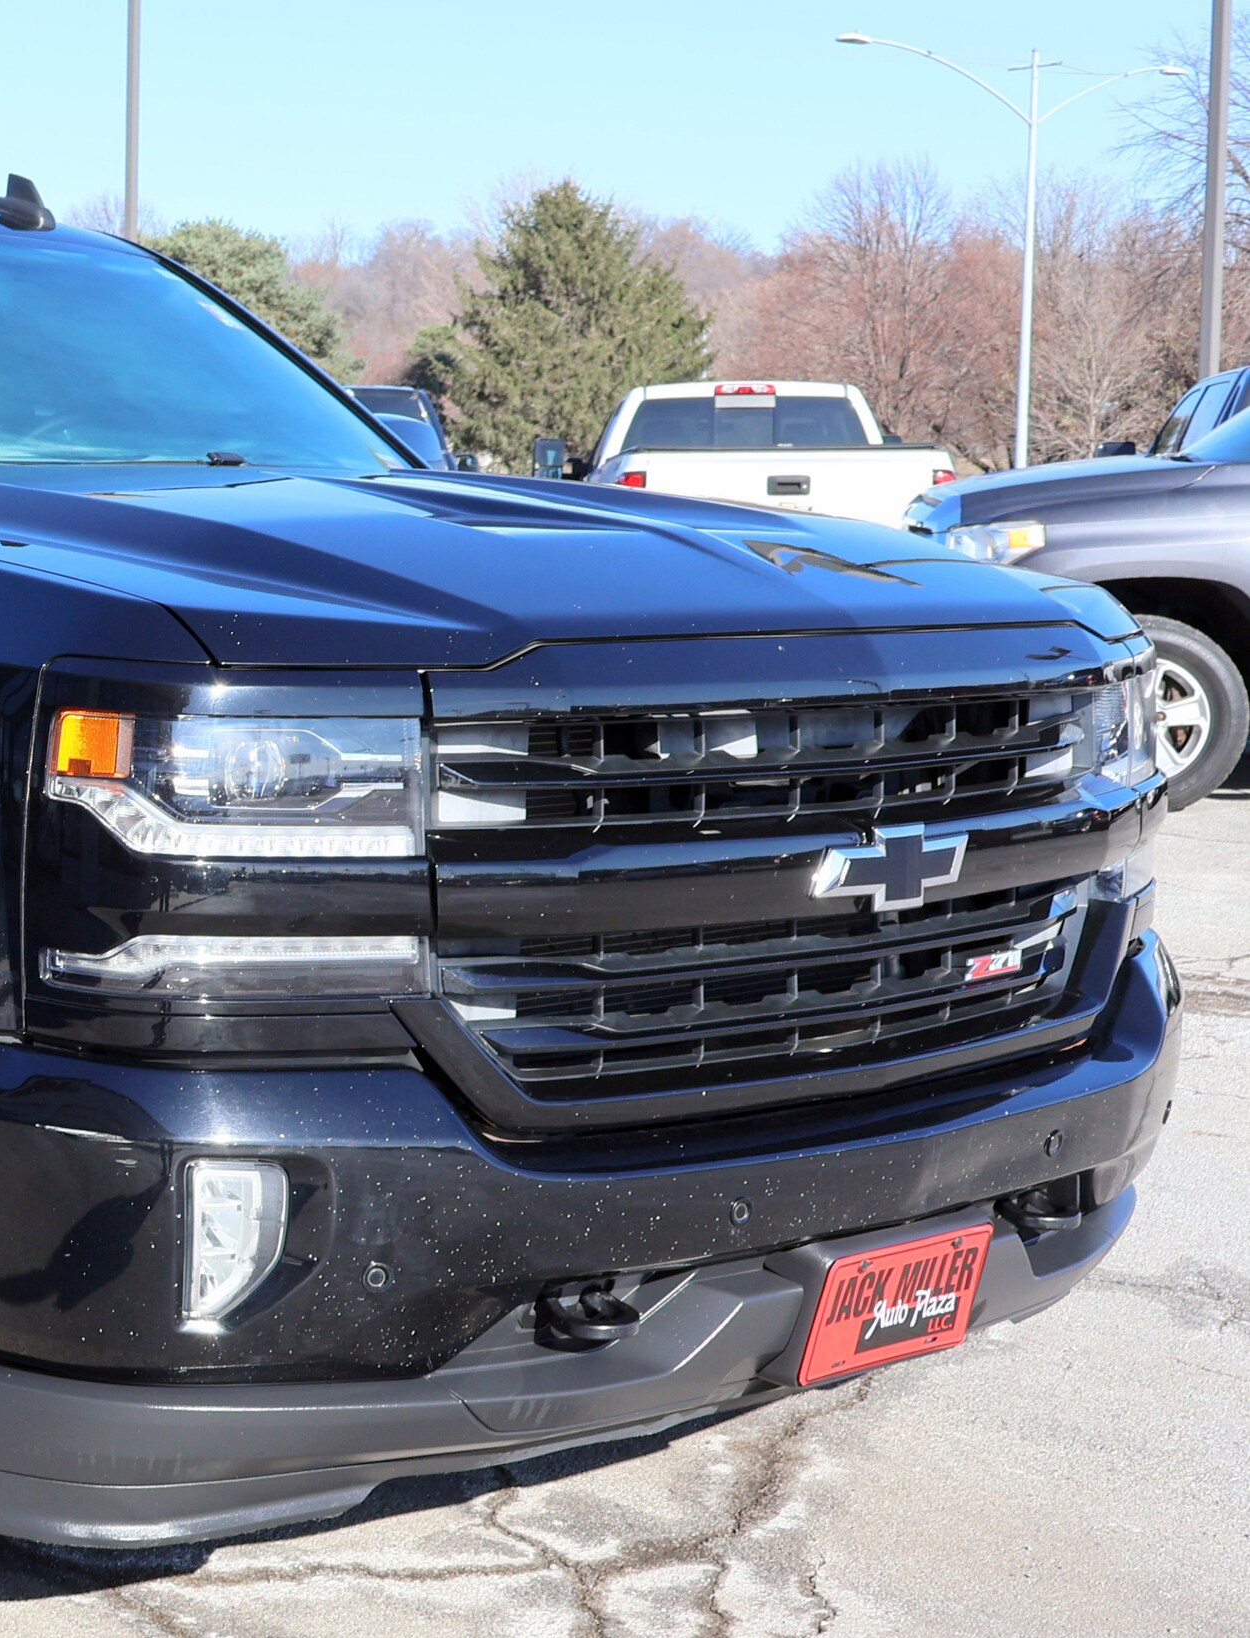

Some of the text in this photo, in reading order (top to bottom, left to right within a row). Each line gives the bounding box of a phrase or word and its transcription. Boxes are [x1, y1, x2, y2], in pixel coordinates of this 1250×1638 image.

[964, 949, 1022, 981] Z71
[825, 1247, 978, 1326] JACK MILLER
[865, 1289, 956, 1340] Auto Plaza
